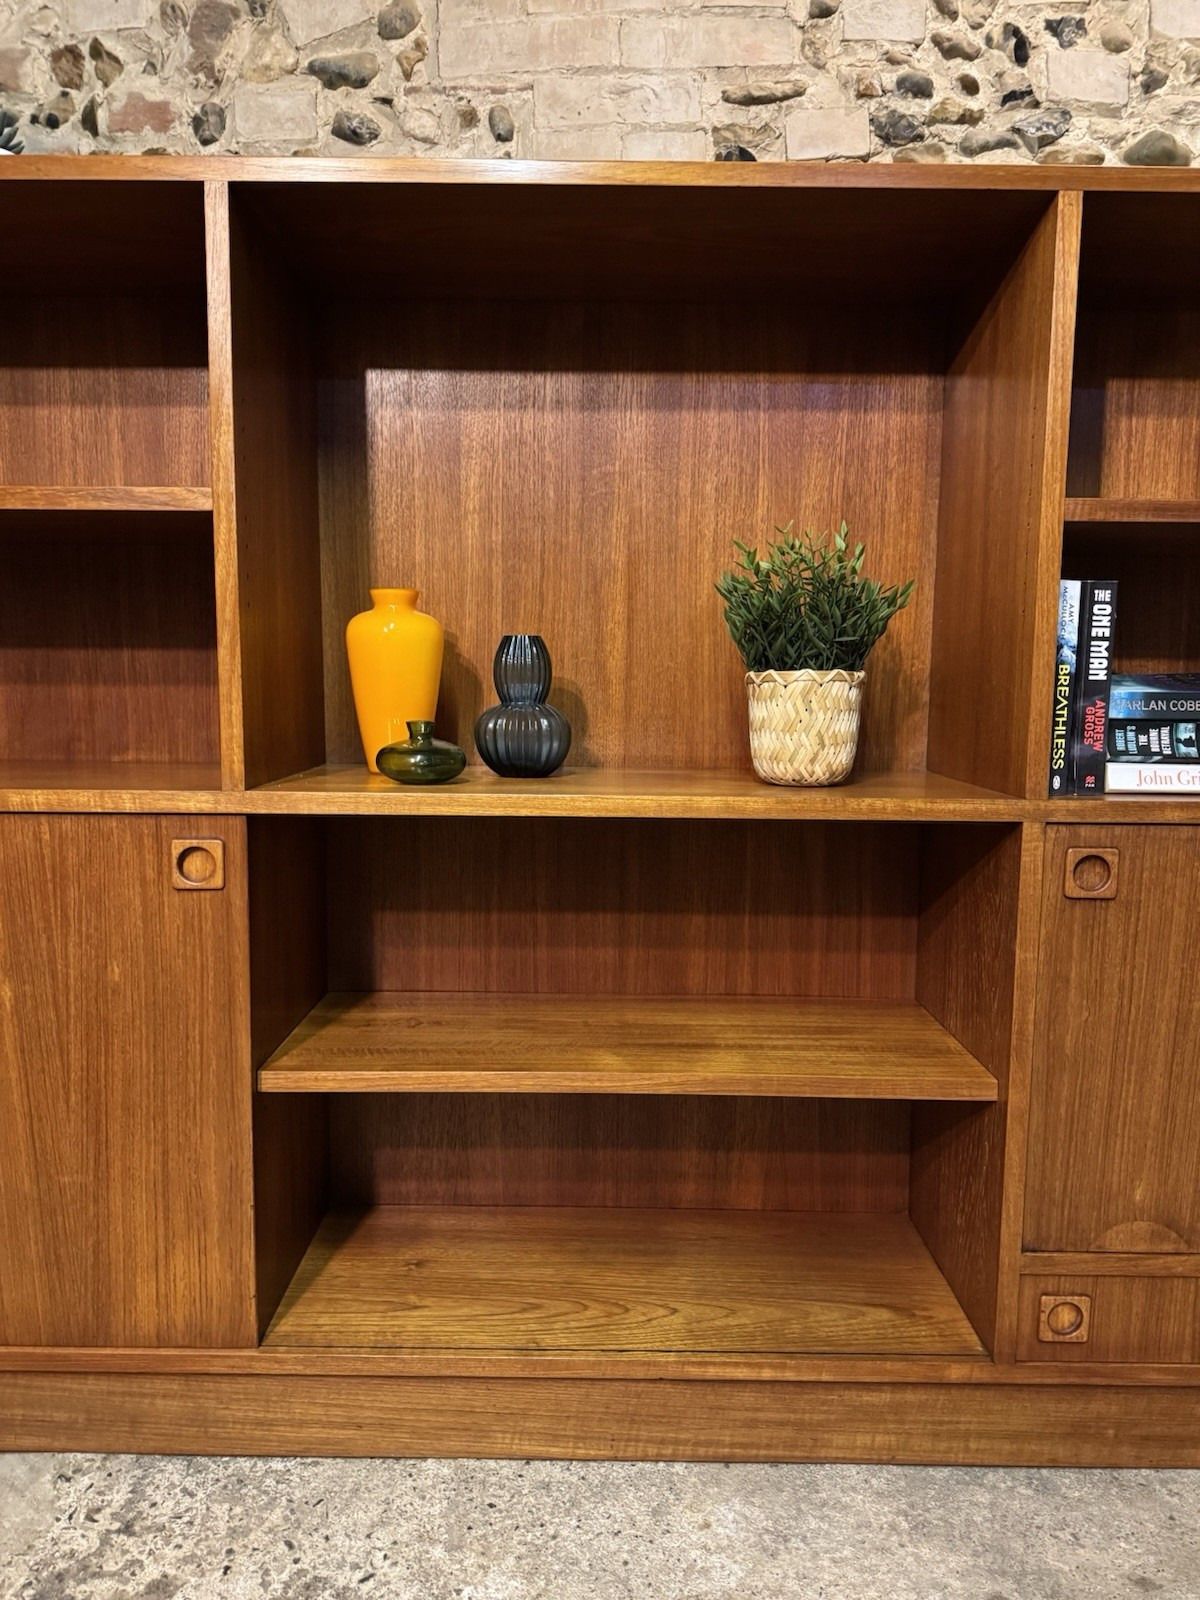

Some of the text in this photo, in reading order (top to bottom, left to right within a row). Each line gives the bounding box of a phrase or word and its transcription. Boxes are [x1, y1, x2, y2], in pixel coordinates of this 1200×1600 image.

[1088, 589, 1112, 680] THE ONE MAN
[1052, 664, 1071, 770] BREATHLESS
[1084, 706, 1095, 745] GROSS
[1093, 700, 1106, 752] ANDREW
[1136, 768, 1173, 787] John
